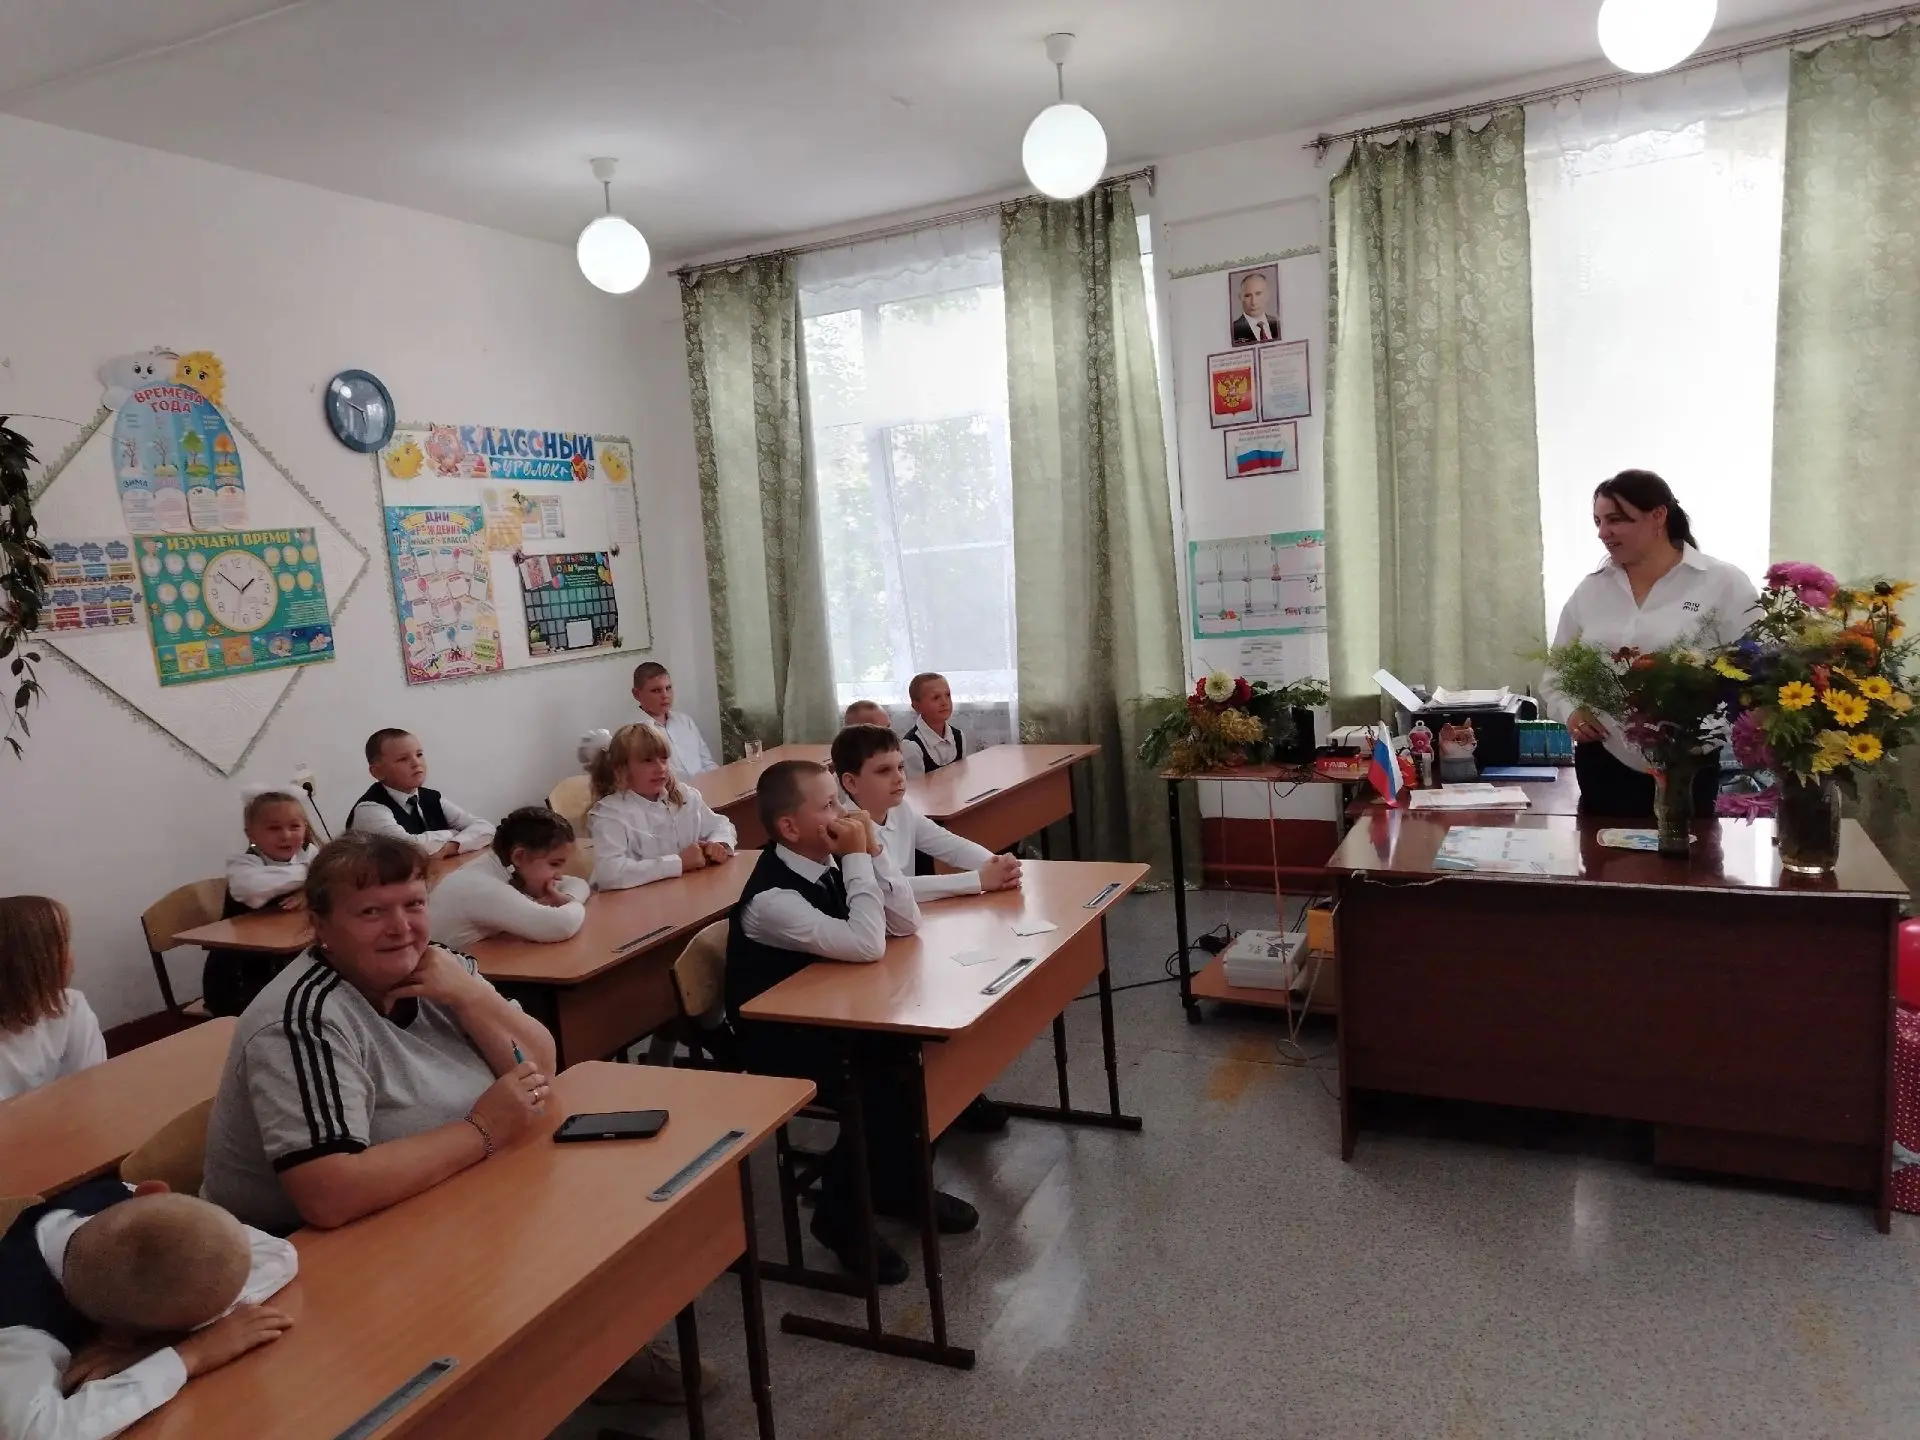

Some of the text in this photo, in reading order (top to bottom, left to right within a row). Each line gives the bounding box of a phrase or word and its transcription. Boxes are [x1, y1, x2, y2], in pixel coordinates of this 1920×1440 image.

[134, 386, 205, 405] ВРЕМЕНА
[151, 400, 191, 413] ГОДА
[459, 425, 594, 461] КЛАССНЫЙ
[502, 460, 560, 478] УГОЛОК
[123, 479, 148, 488] ЗИМА
[425, 511, 450, 522] ДНИ
[166, 532, 291, 551] ИЗУЧАЕМ ВРЕМЯ
